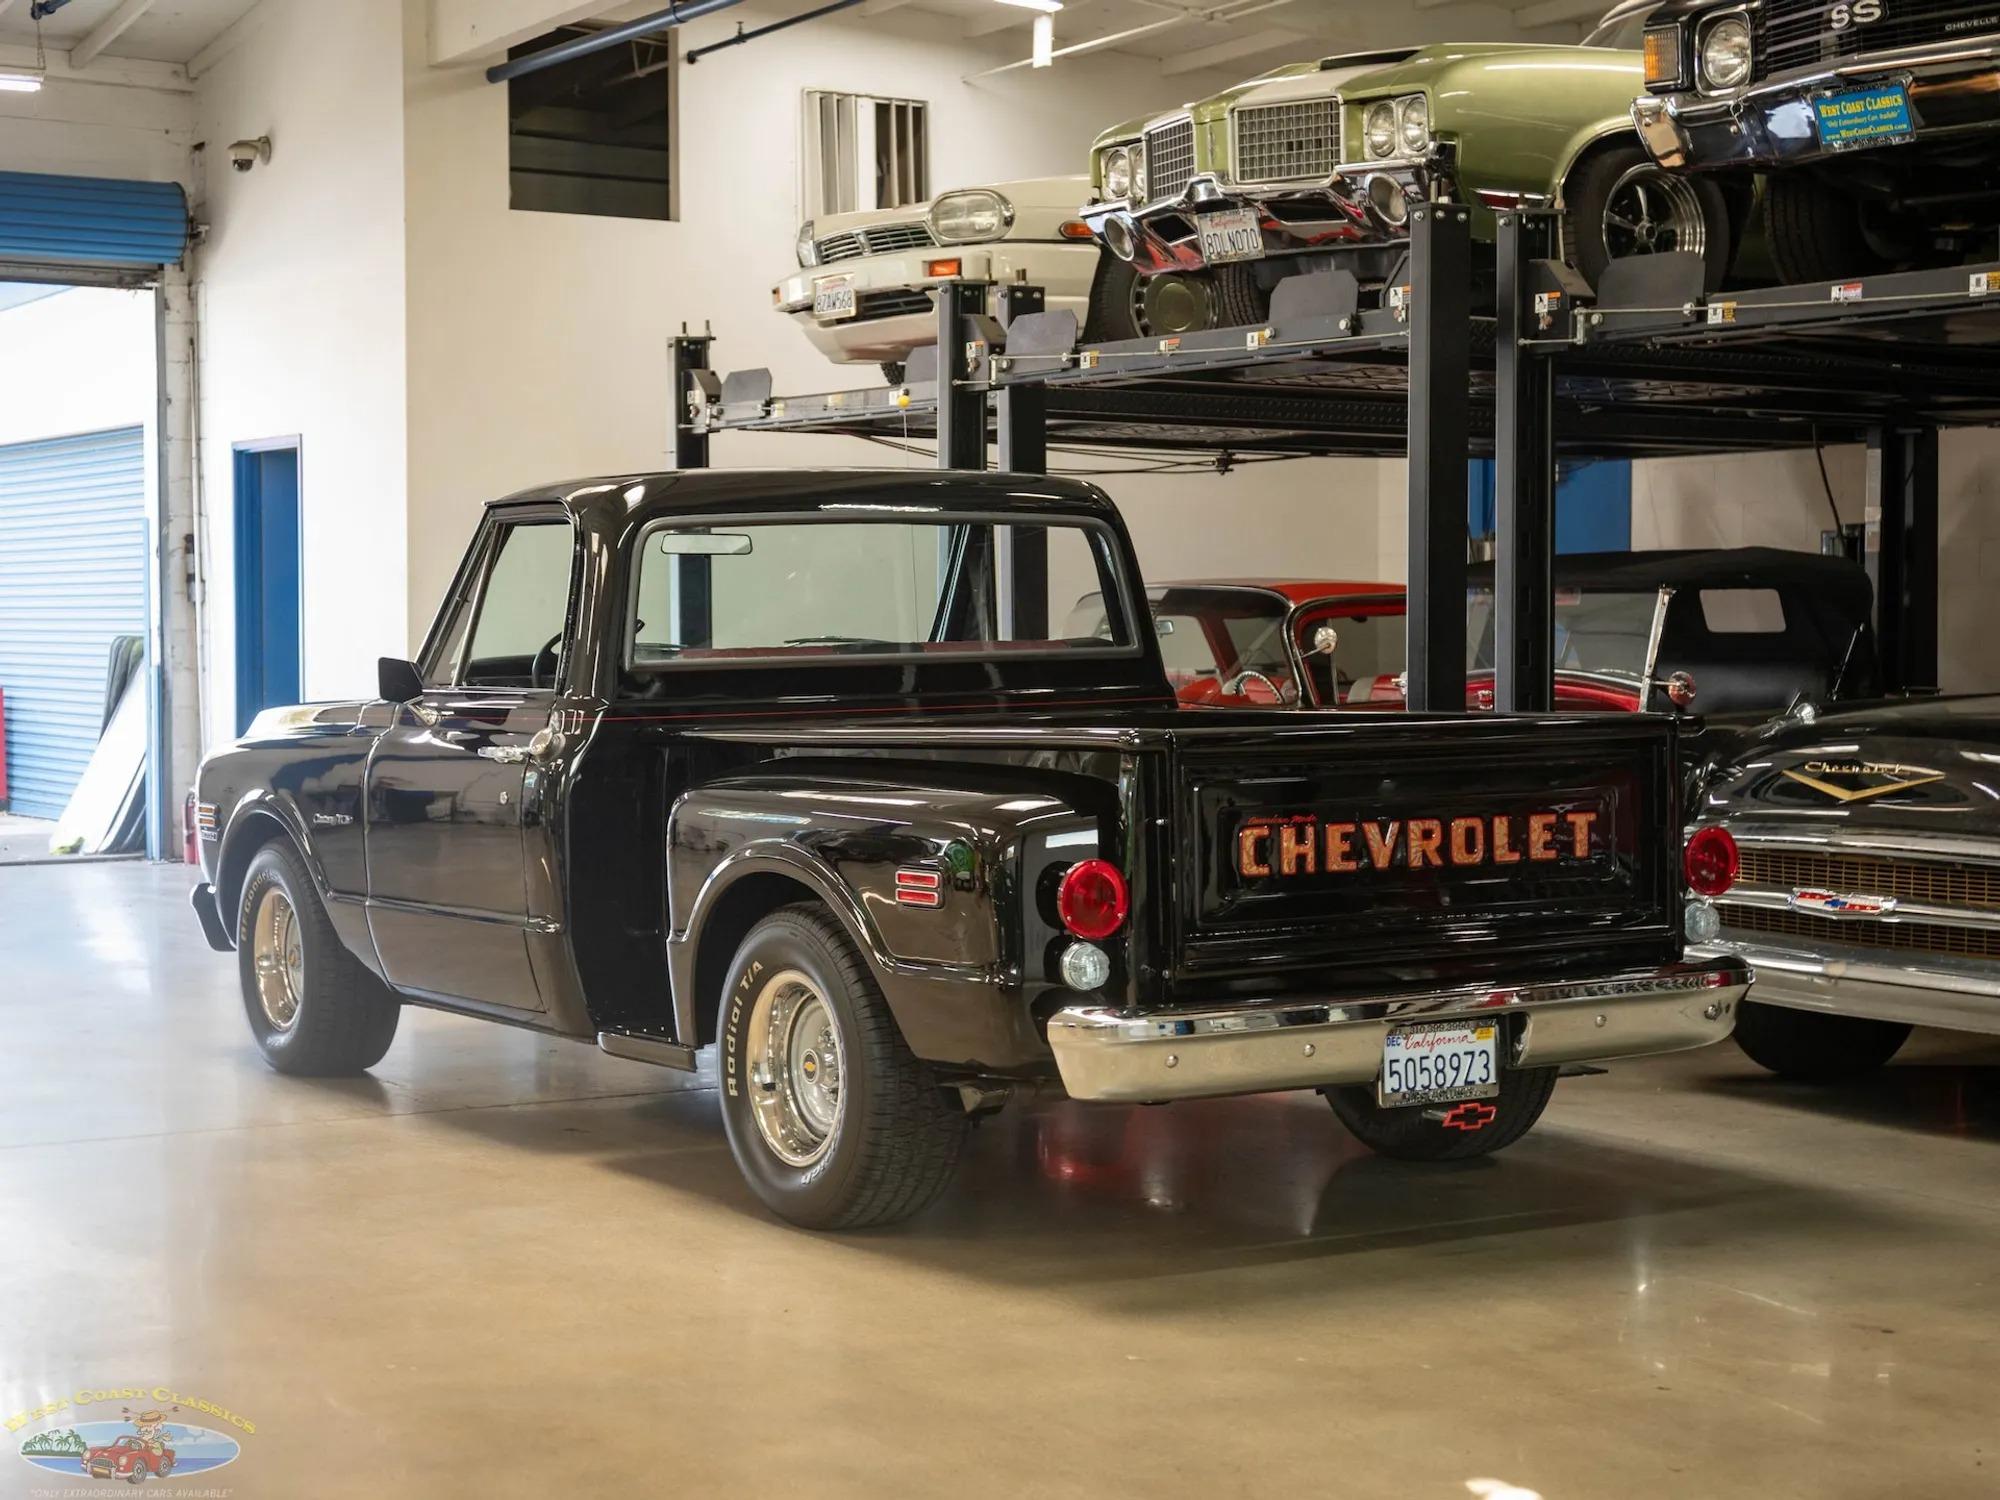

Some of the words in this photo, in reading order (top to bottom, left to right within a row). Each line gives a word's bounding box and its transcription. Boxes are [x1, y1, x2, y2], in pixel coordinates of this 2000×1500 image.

[1831, 0, 1882, 29] SS
[1945, 15, 1999, 31] CHEVELLE
[1819, 104, 1840, 118] WEST
[1841, 100, 1865, 114] COAST
[1866, 95, 1904, 110] CLASSICS
[1804, 761, 1911, 776] Chevrolet
[1238, 811, 1597, 878] CHEVROLET
[726, 996, 743, 1097] Radial
[740, 960, 764, 990] T/A
[1386, 1036, 1401, 1047] DEC
[1404, 1032, 1476, 1053] California
[1389, 1049, 1490, 1093] 50589Z3
